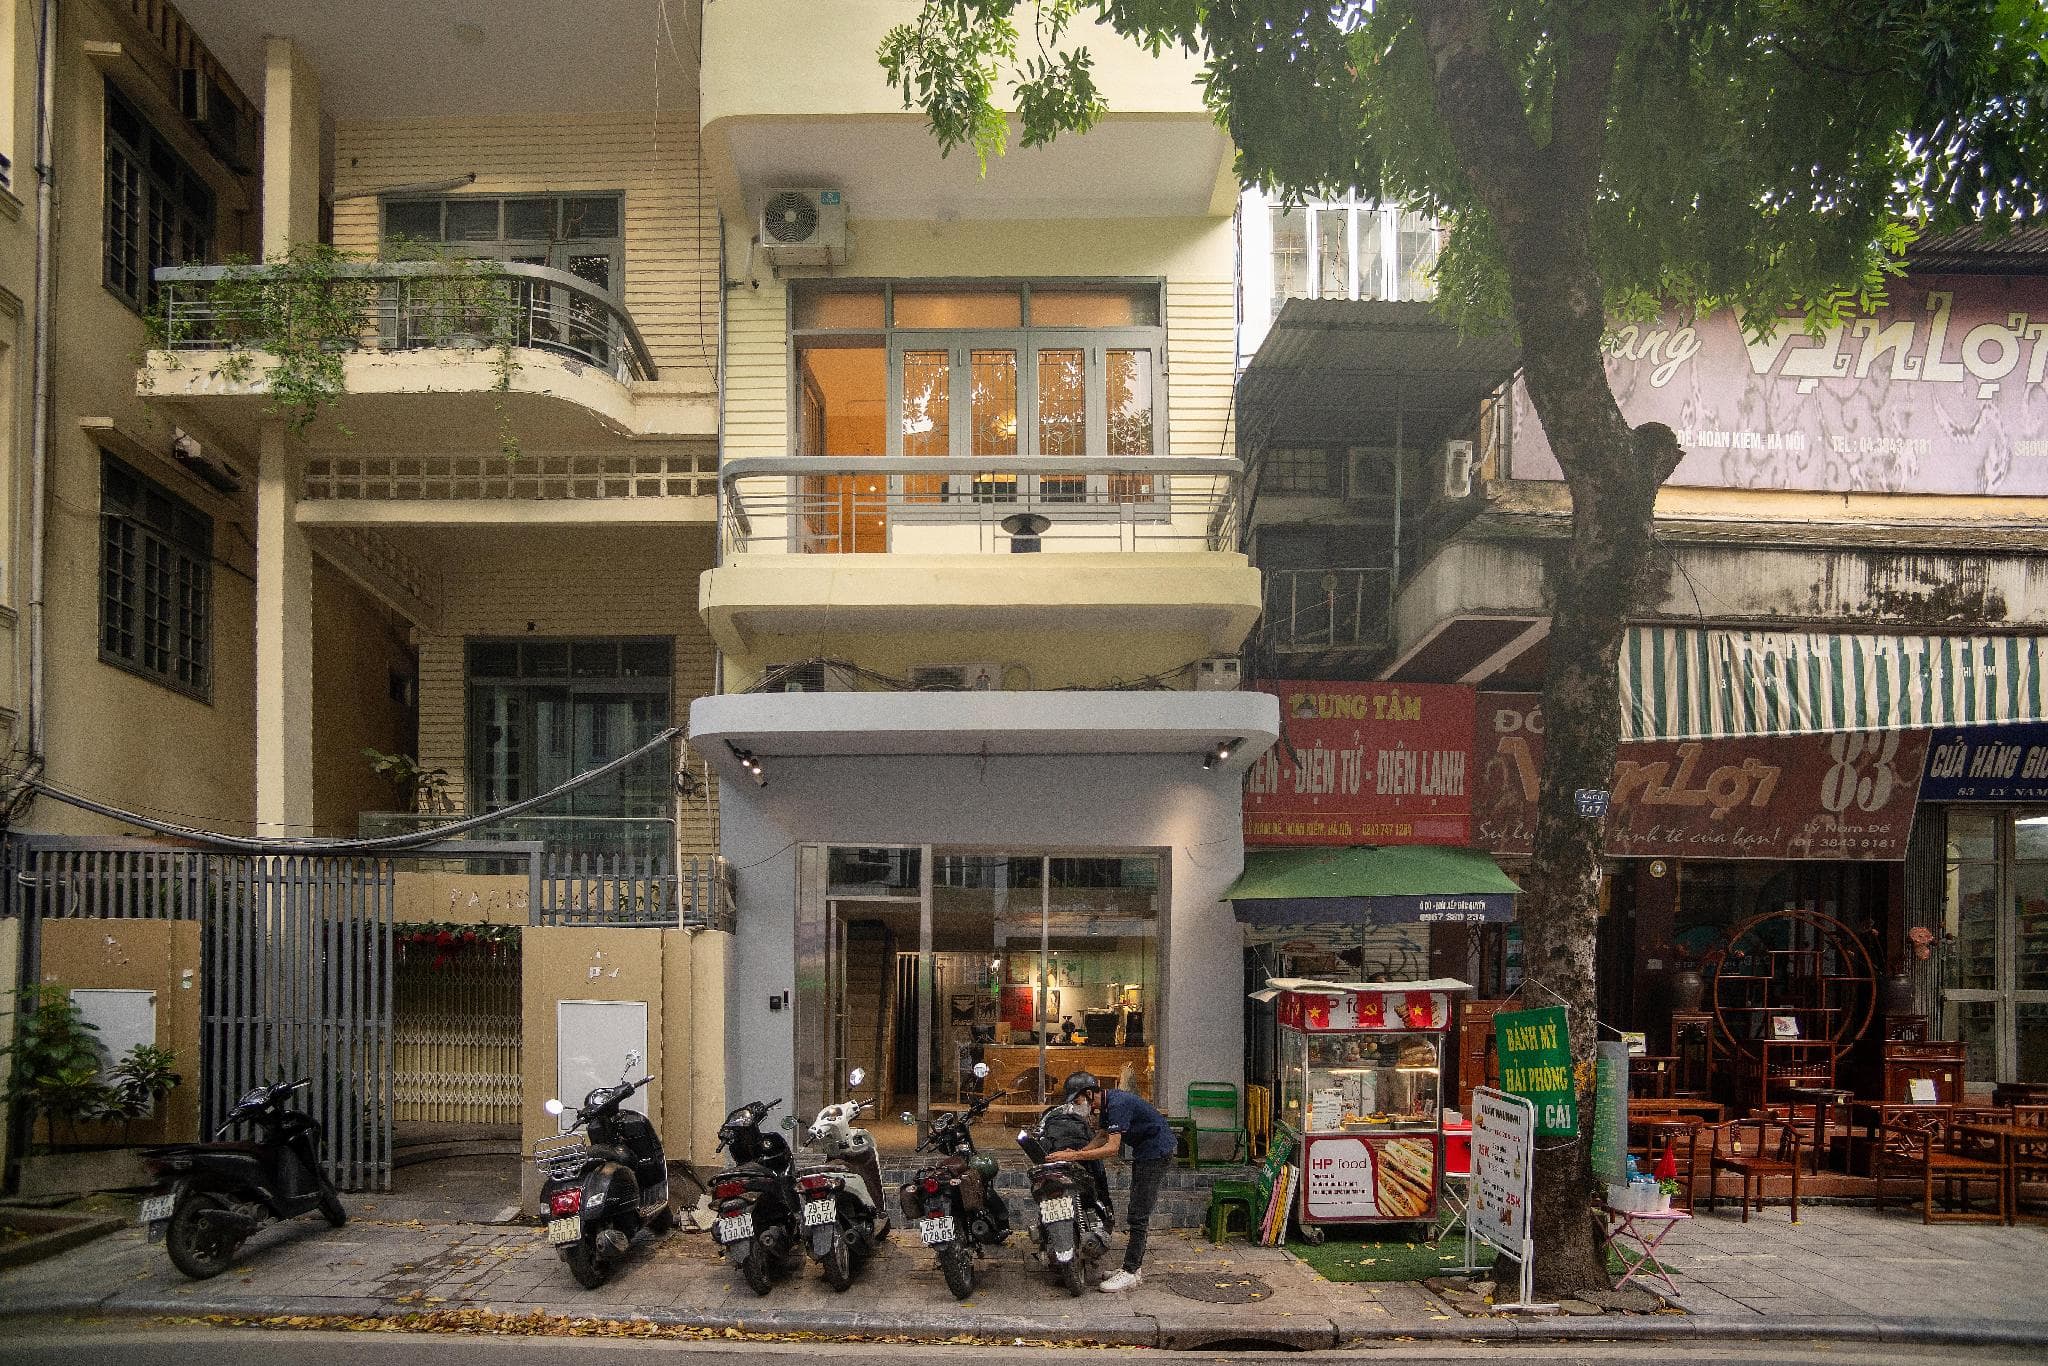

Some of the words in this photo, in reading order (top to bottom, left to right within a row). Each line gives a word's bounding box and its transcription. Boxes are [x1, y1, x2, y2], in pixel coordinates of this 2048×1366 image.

[1373, 689, 1422, 721] TÂM
[1296, 739, 1336, 804] ĐIỆN
[1377, 740, 1418, 806] ĐIỆN
[1421, 751, 1466, 806] LẠNH
[1821, 729, 1900, 812] 83
[1930, 735, 1968, 778] CỬA
[1969, 740, 2022, 778] HÀNG
[1957, 787, 1975, 796] 83
[1581, 804, 1601, 814] 147
[1826, 824, 1863, 833] Nam
[1505, 1021, 1539, 1052] BÁNH
[1528, 1059, 1569, 1092] PHÒNG
[1545, 1098, 1572, 1130] CÁI
[1312, 1158, 1334, 1170] HP
[1338, 1157, 1367, 1169] food
